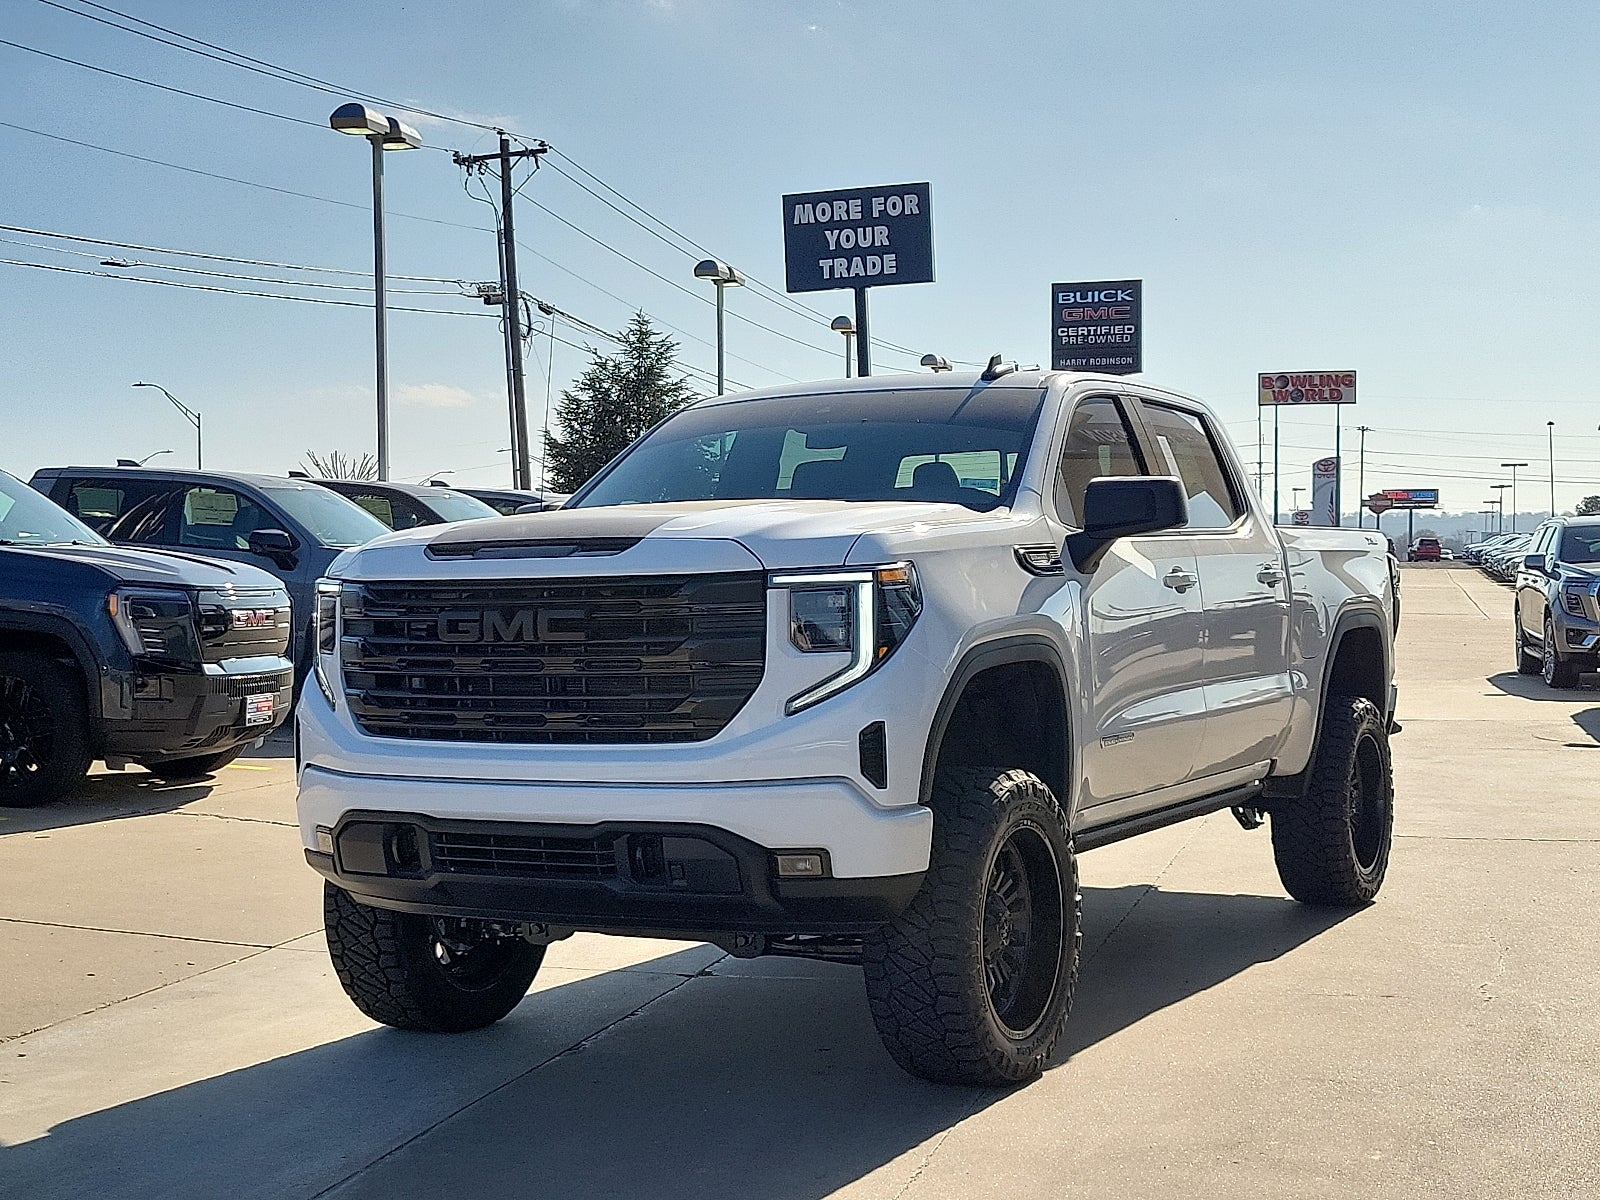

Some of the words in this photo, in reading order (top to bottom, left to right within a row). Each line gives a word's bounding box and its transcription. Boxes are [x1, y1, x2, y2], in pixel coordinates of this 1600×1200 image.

[793, 199, 862, 225] MORE
[872, 194, 920, 218] FOR
[824, 225, 890, 250] YOUR
[819, 254, 897, 279] TRADE
[1058, 289, 1134, 304] BUICK
[1062, 306, 1131, 321] GMC
[1057, 325, 1135, 336] CERTIFIED
[1062, 334, 1131, 345] PRE-OWNED
[1060, 358, 1087, 366] HARRY
[1089, 357, 1133, 366] ROBINSON
[1261, 374, 1354, 389] BOWLING
[1272, 388, 1343, 402] WORLD
[232, 609, 275, 627] GMC
[438, 608, 587, 643] GMC
